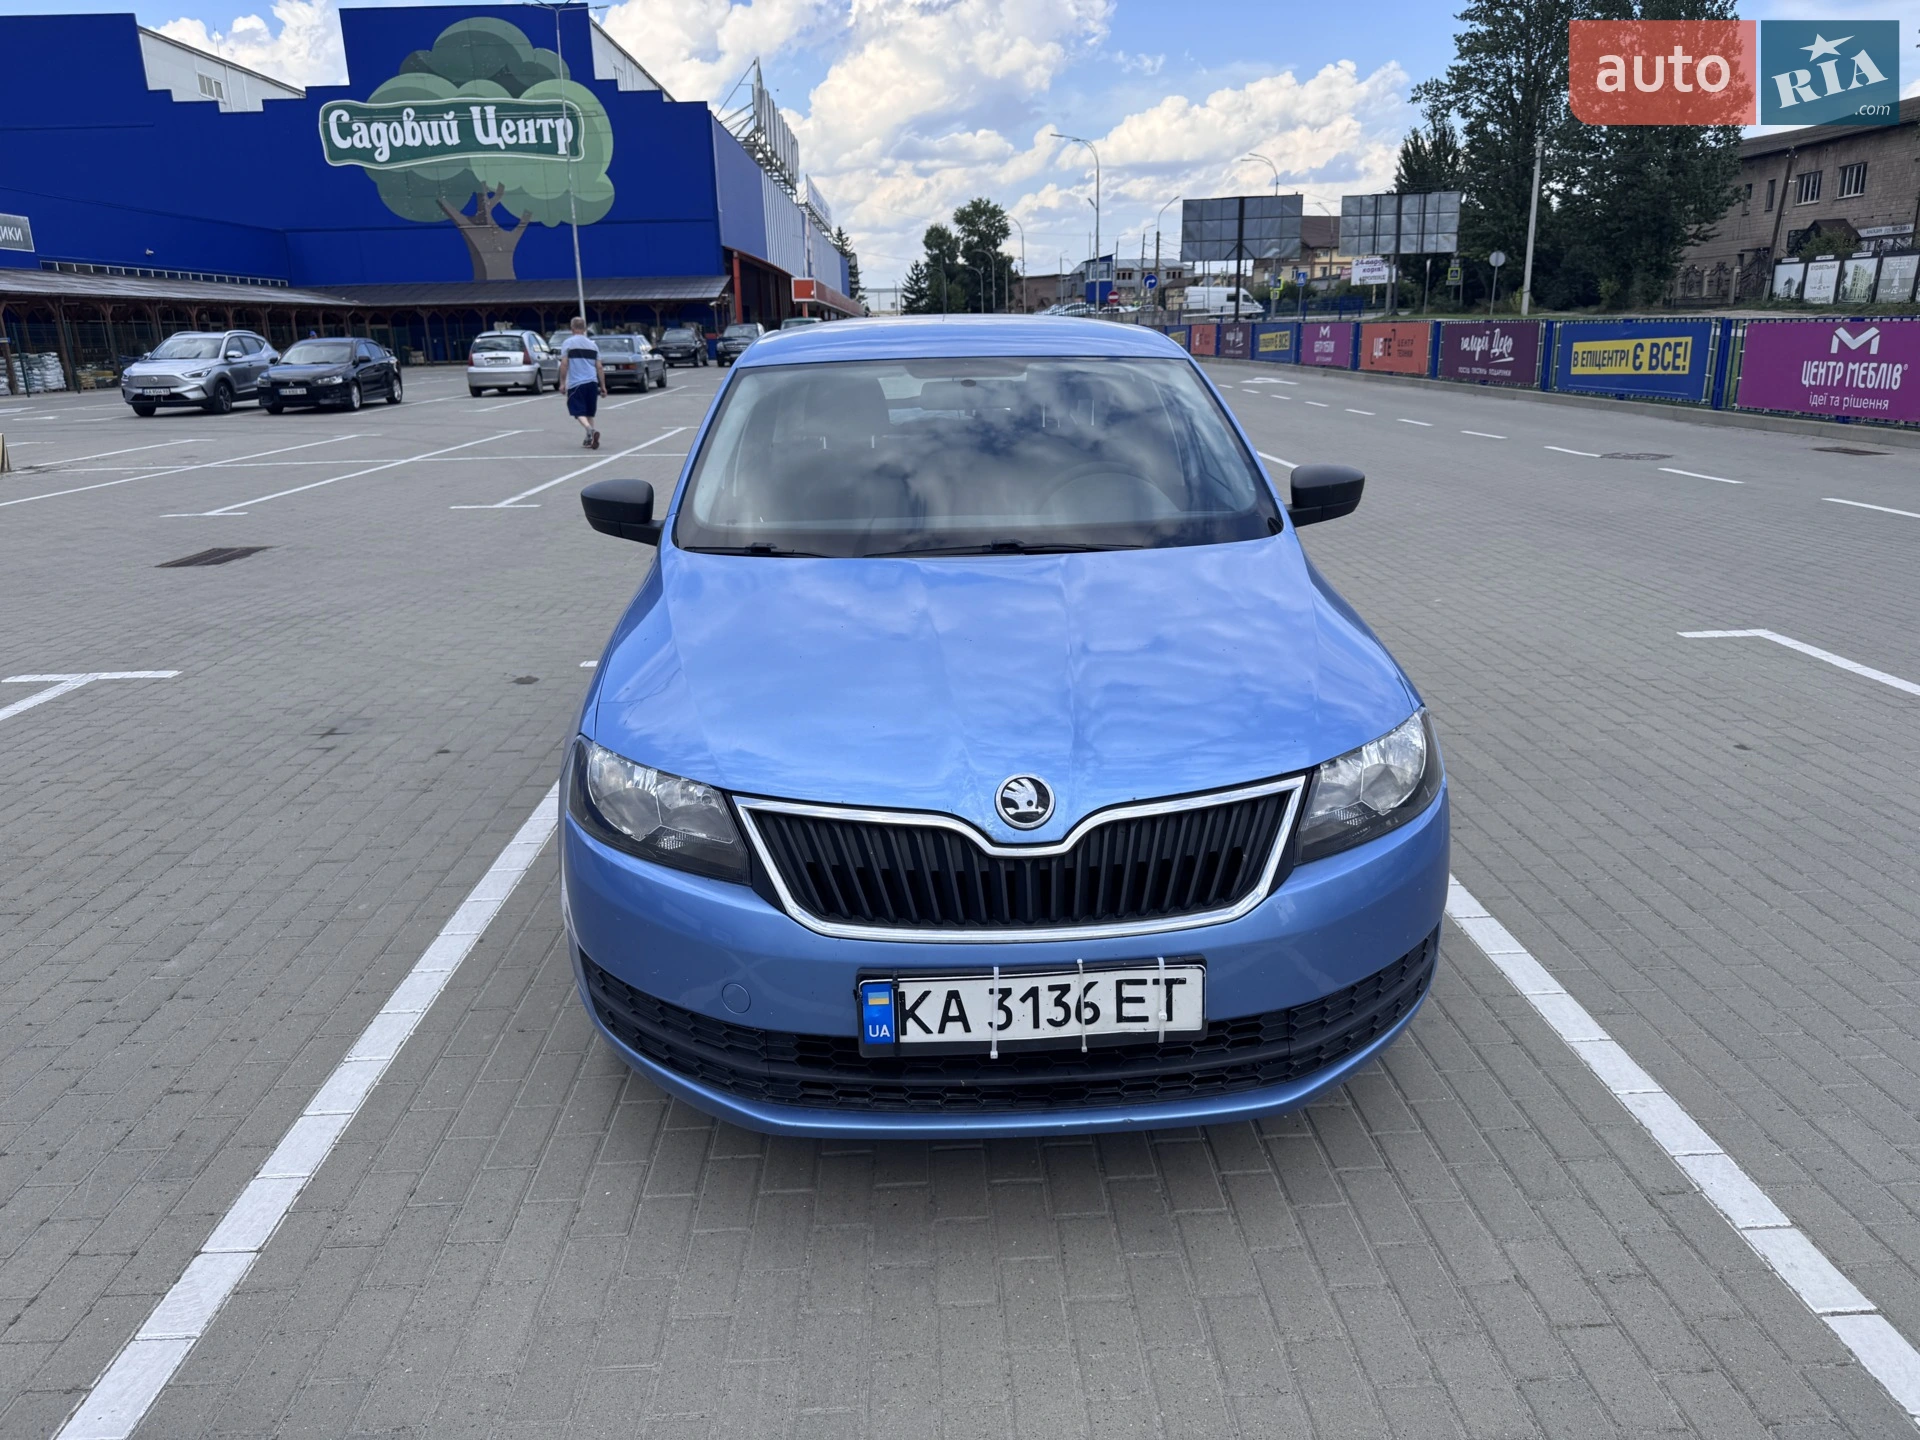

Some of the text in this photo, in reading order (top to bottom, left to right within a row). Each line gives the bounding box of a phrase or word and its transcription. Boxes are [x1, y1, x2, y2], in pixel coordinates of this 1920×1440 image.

[328, 105, 574, 162] Садовий Центр
[1572, 341, 1689, 372] В ЕПІЦЕНТРІ Є ВСЕ!
[1801, 360, 1844, 388] ЦЕНТР
[1808, 391, 1890, 411] ідеї та рішення
[900, 977, 1187, 1036] KA 3136 ET
[868, 1025, 891, 1038] UA
